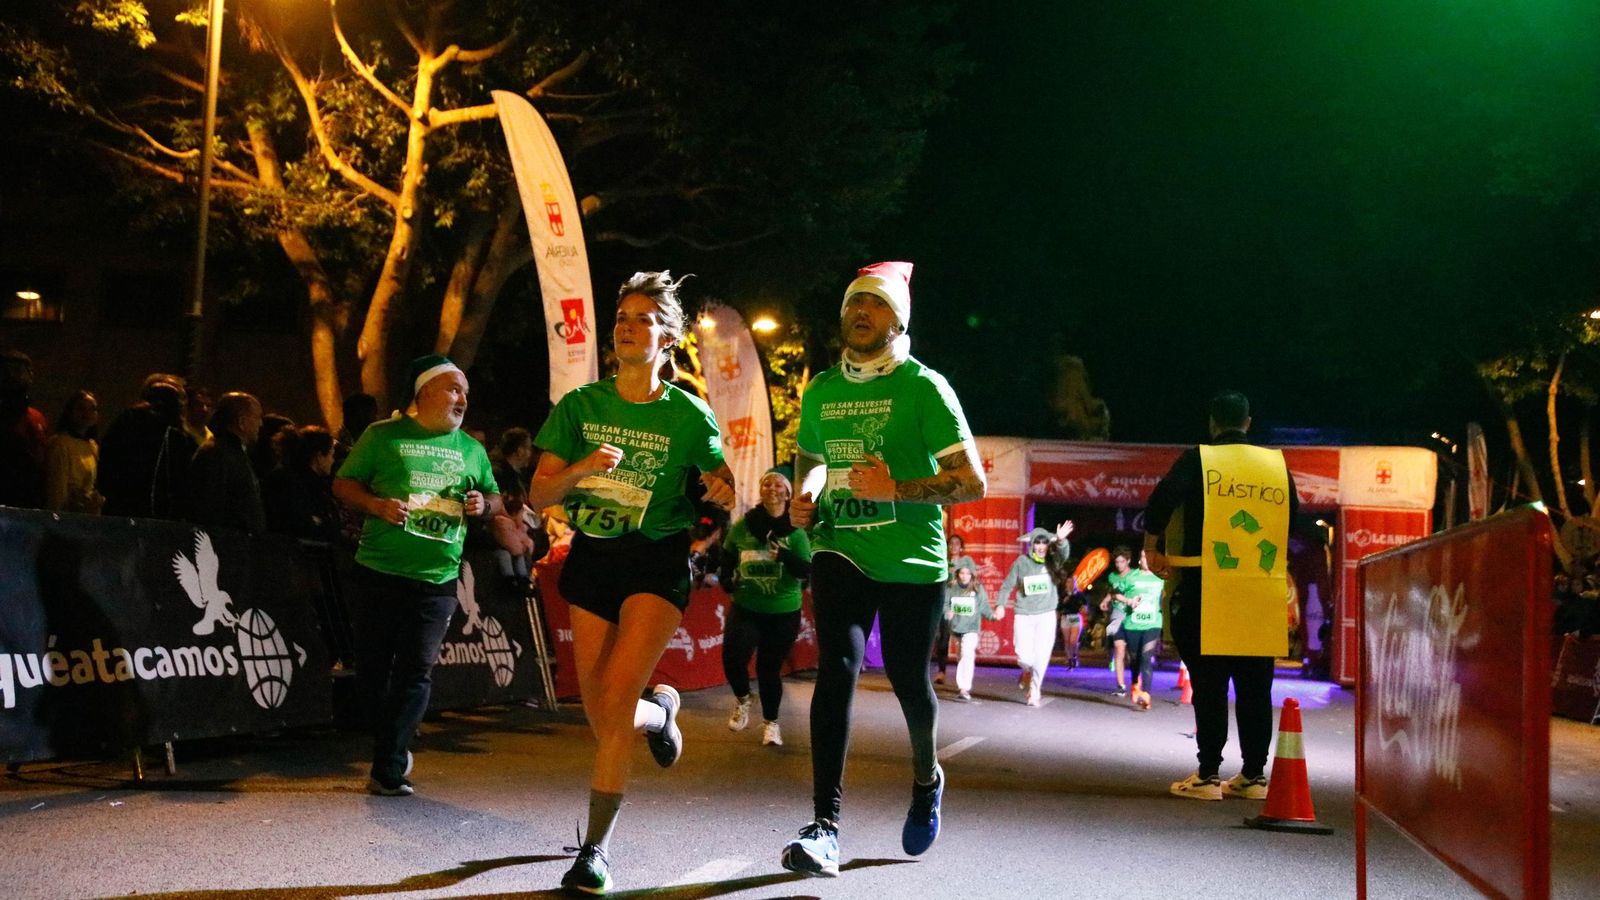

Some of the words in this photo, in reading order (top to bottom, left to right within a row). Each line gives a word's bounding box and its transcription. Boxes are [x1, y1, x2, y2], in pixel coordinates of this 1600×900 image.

[820, 409, 846, 418] CIUDAD
[847, 408, 858, 416] DE
[821, 402, 836, 410] XVII
[837, 401, 853, 409] SAN
[853, 399, 893, 409] SILVESTRE
[582, 423, 599, 432] XVII
[601, 425, 621, 435] SAN
[623, 429, 670, 445] SILVESTRE
[582, 431, 612, 443] CIUDAD
[614, 436, 627, 445] DE
[629, 439, 669, 453] ALMERÍA
[568, 501, 632, 533] 1751
[833, 497, 878, 518] 708
[415, 516, 452, 533] 407
[954, 515, 1019, 532] VOLCANICA
